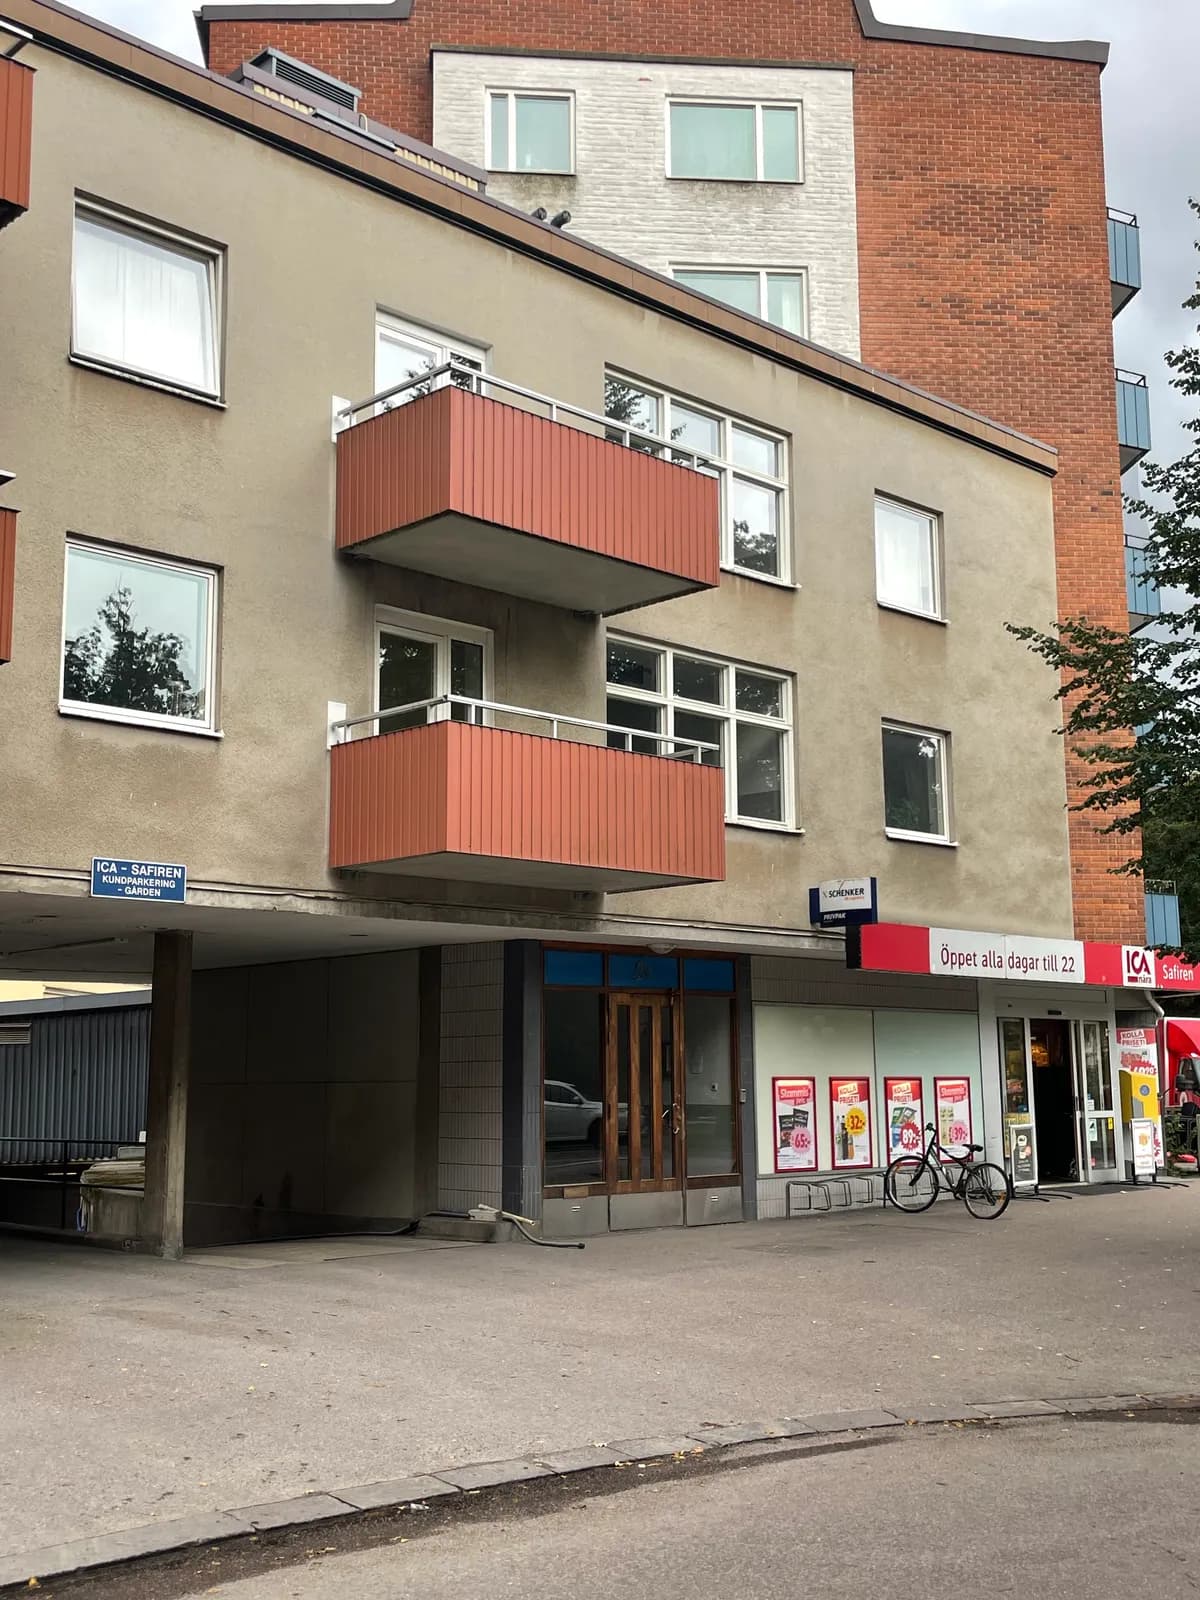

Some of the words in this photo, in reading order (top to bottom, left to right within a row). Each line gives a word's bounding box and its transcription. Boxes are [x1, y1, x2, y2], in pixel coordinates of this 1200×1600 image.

[97, 861, 118, 874] ICA
[131, 864, 182, 879] SAFIREN
[102, 875, 176, 889] KUNDPARKERING
[125, 885, 161, 897] GÅRDEN
[828, 888, 865, 898] SCHENKER
[940, 943, 978, 969] Öppet
[981, 949, 1003, 969] alla
[1007, 951, 1040, 973] dagar
[1042, 954, 1058, 972] till
[1061, 956, 1075, 973] 22
[1126, 950, 1151, 975] ICA
[1138, 975, 1152, 984] nära
[1162, 964, 1194, 981] Safiren
[1122, 1031, 1143, 1039] KOLLA
